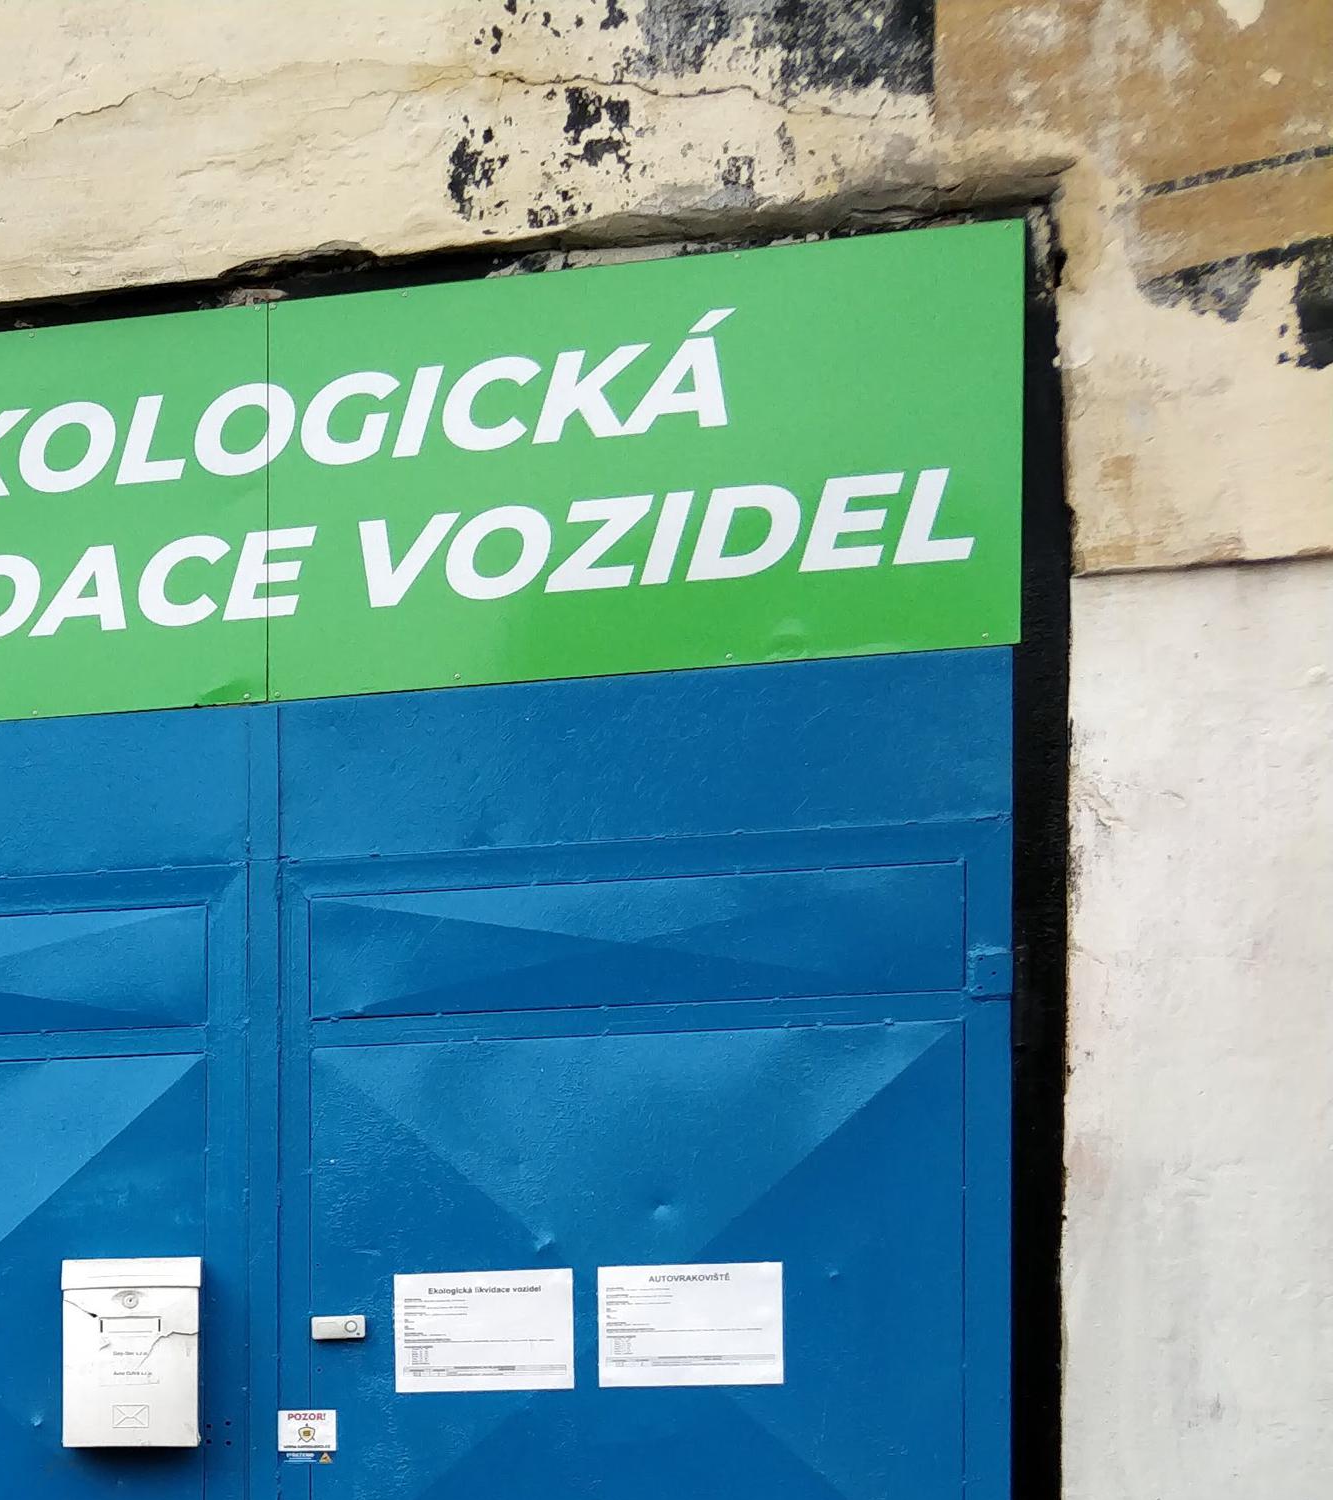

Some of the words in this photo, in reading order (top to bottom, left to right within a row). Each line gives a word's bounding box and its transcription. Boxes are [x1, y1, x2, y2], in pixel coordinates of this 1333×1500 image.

[357, 466, 976, 609] VOZIDEL
[428, 1286, 473, 1296] Ekologická
[475, 1285, 510, 1294] likvidace
[512, 1284, 542, 1293] vozidel
[287, 1412, 327, 1421] POZOR!
